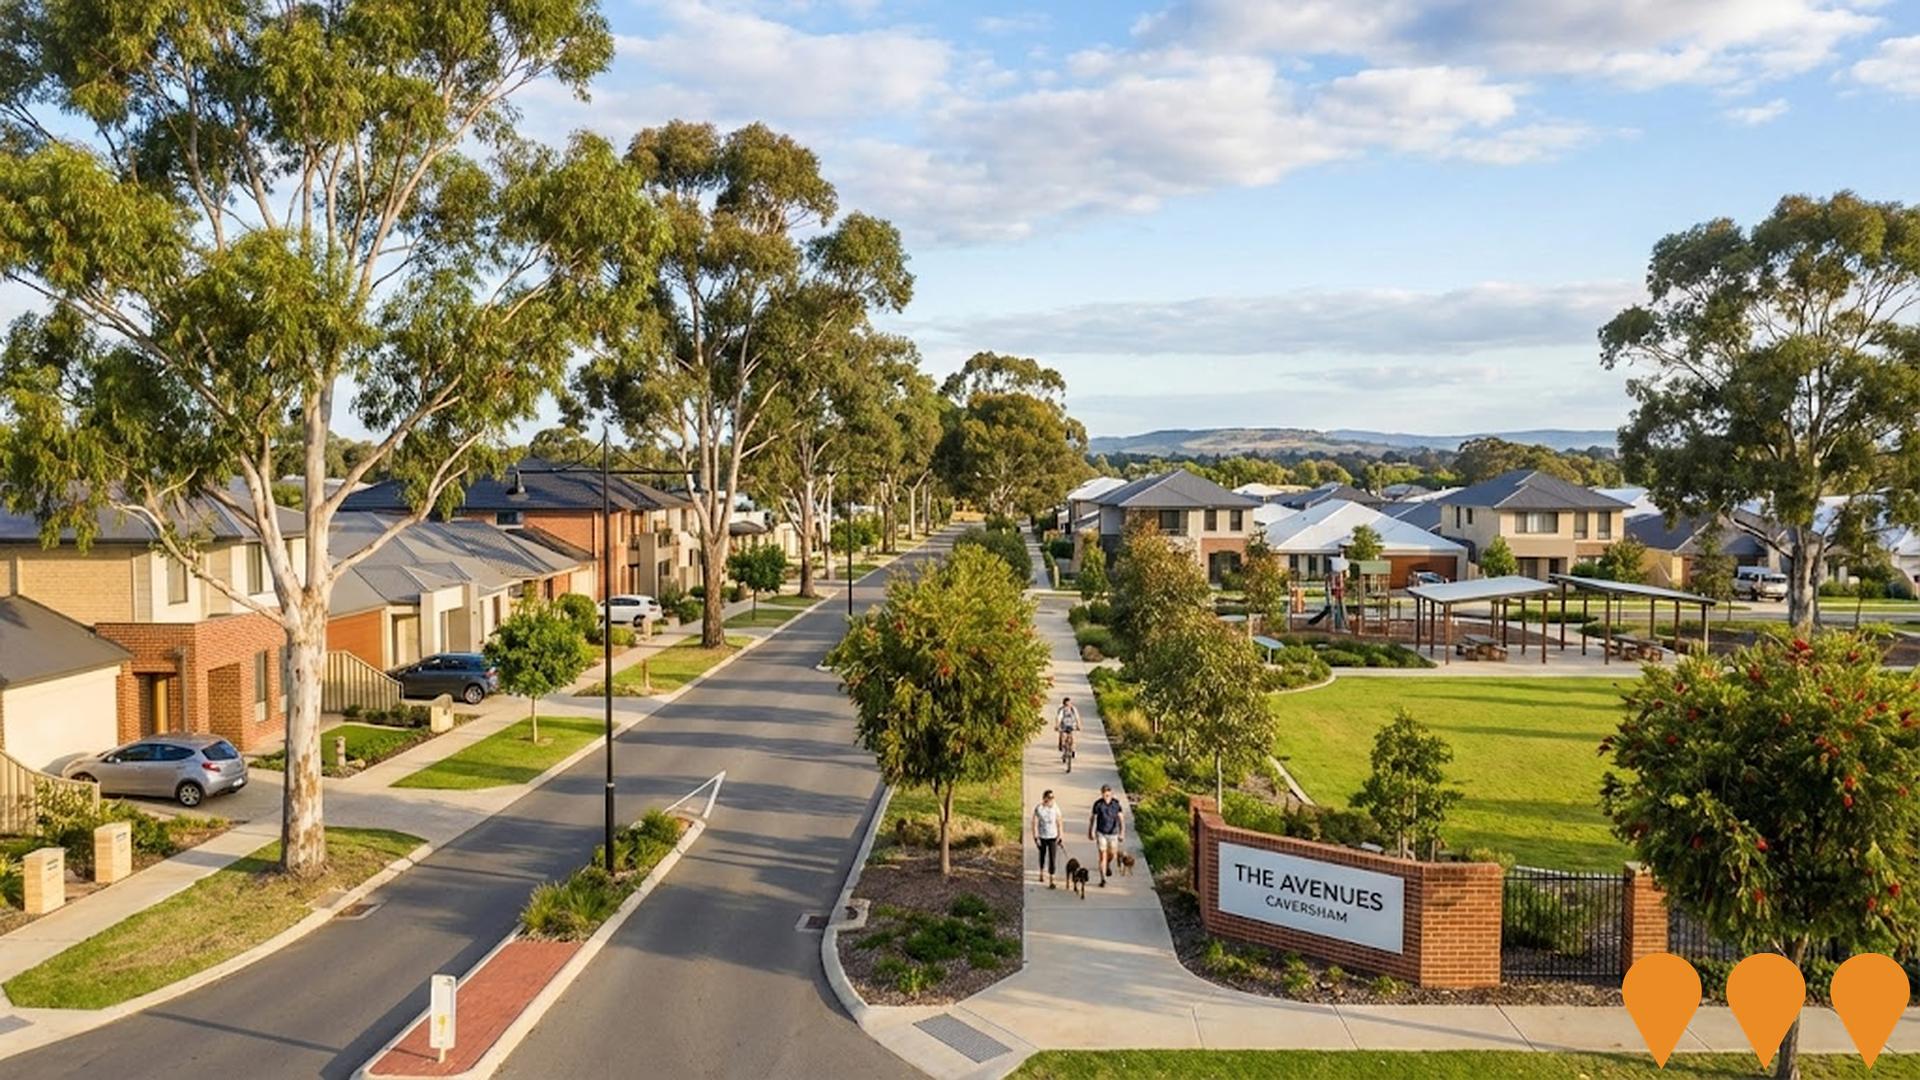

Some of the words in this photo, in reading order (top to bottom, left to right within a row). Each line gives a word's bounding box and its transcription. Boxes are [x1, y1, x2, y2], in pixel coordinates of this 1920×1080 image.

[1234, 863, 1274, 889] THE
[1280, 874, 1384, 911] AVENUES
[1265, 894, 1348, 923] CAVERSHAM
